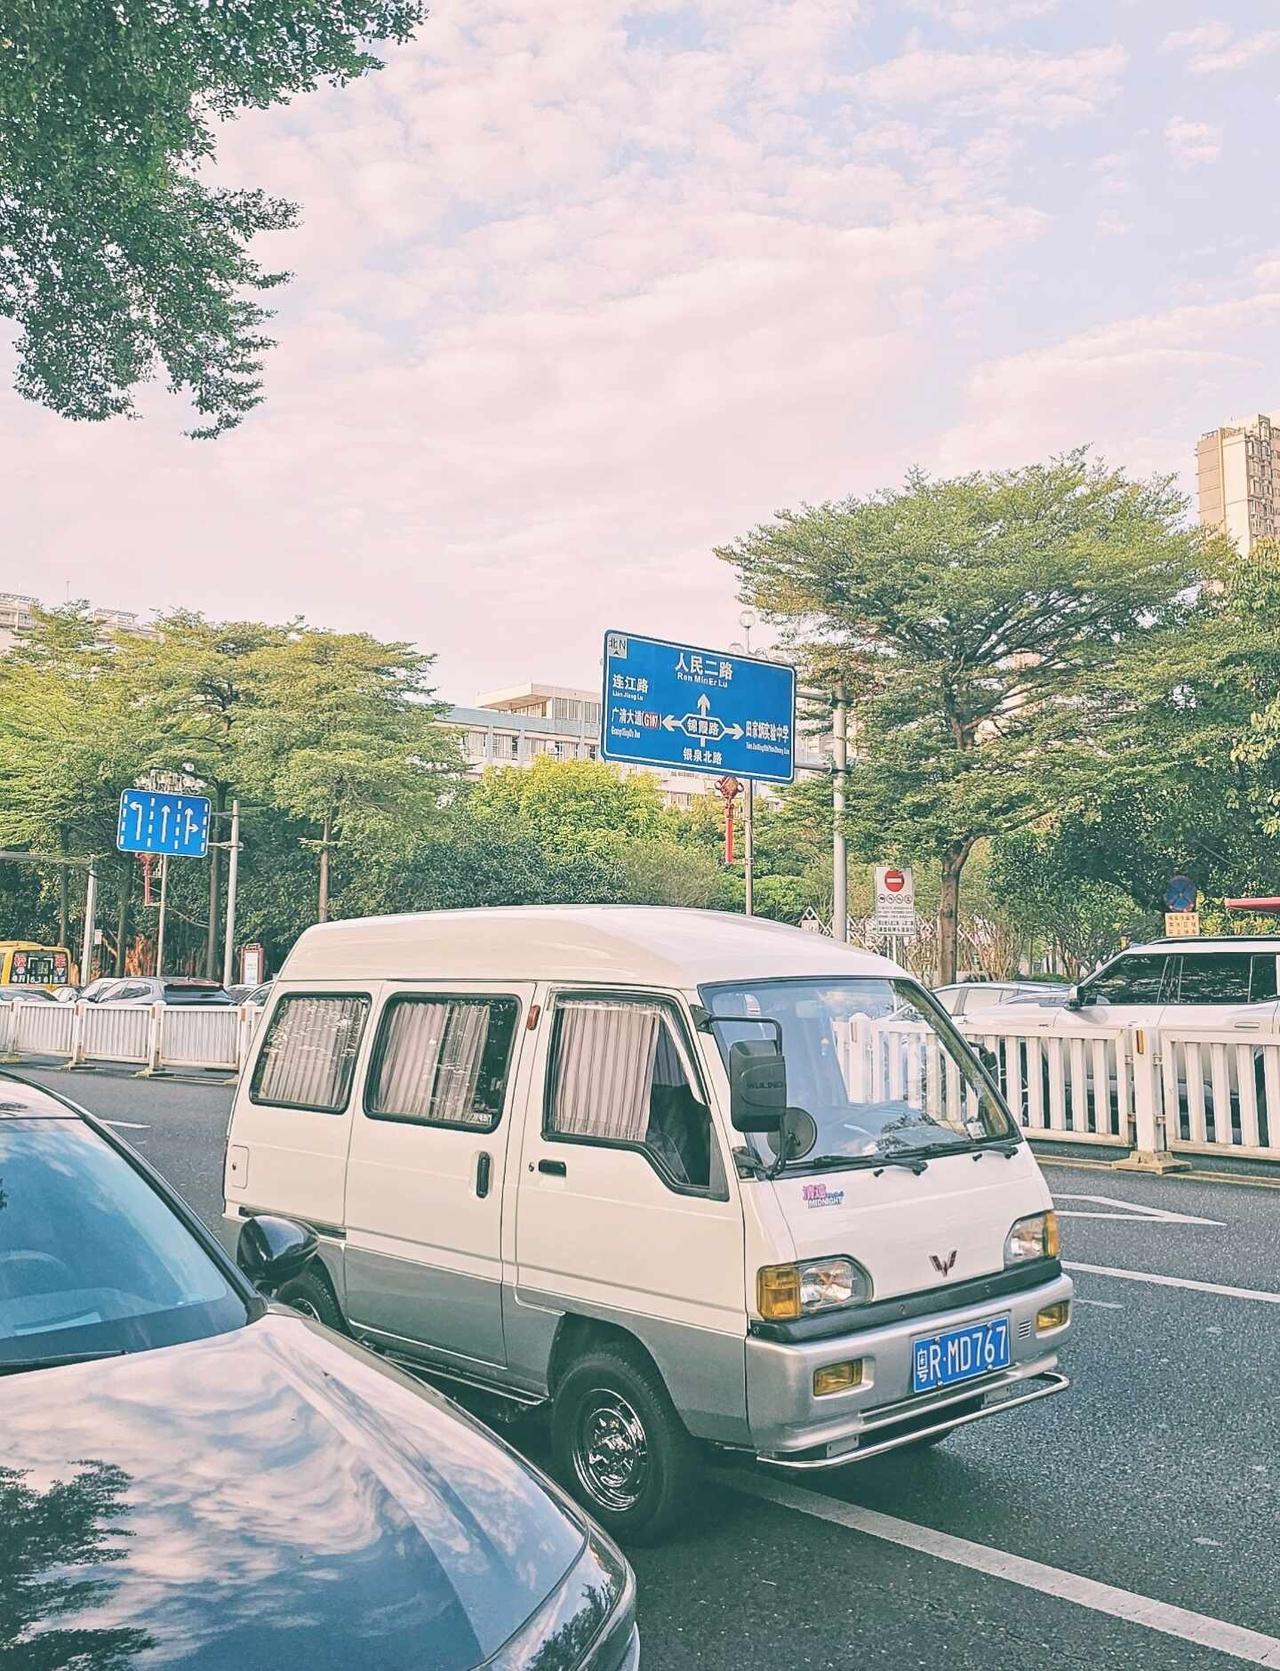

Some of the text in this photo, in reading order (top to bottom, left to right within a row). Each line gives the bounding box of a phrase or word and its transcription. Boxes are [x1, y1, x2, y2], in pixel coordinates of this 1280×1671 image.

[607, 637, 626, 650] 北 N
[675, 652, 733, 681] 人民二路
[612, 673, 649, 694] 连江路
[683, 747, 723, 765] 银泉北路
